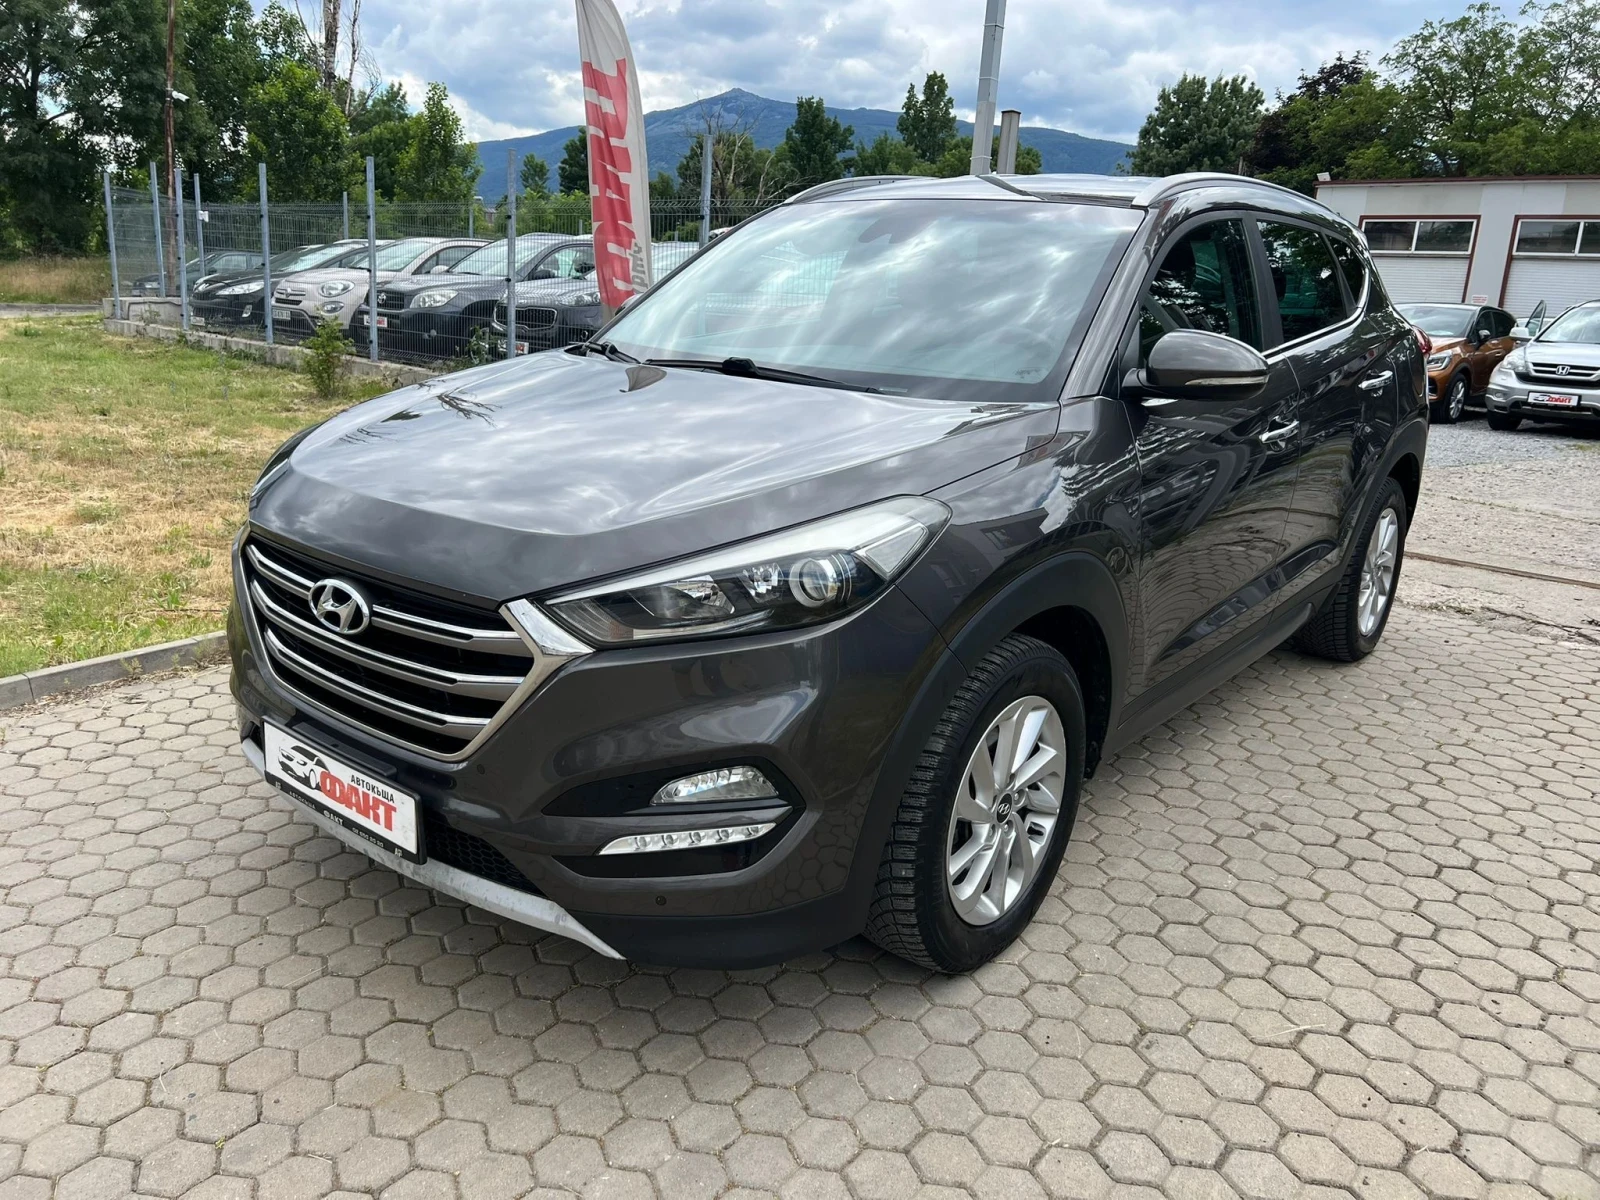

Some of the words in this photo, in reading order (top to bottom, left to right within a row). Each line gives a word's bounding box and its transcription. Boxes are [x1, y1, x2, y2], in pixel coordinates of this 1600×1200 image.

[320, 770, 397, 832] ФАКТ
[350, 774, 395, 804] АВТОКЪЩА
[323, 810, 344, 826] ФАКТ
